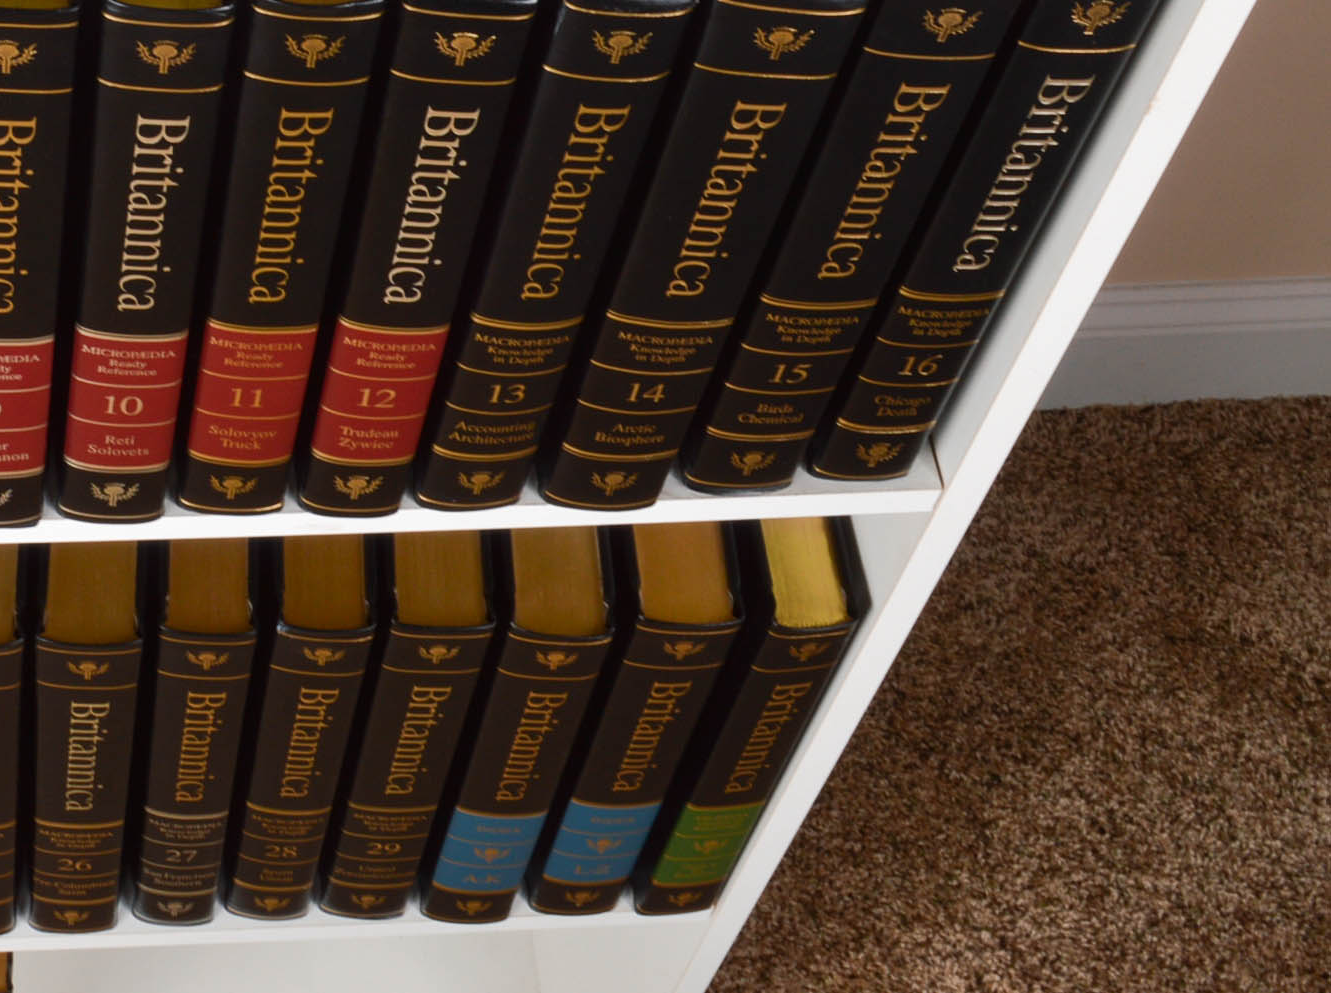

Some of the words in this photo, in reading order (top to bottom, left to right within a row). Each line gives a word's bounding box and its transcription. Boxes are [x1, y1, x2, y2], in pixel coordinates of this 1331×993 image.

[817, 81, 952, 280] Britannica
[952, 73, 1096, 273] Britannica
[248, 107, 334, 305] Britannica
[383, 105, 481, 305] Britannica
[520, 103, 631, 301] Britannica
[665, 100, 787, 298] Britannica
[117, 113, 191, 312] Britannica
[109, 359, 147, 369] Ready
[224, 358, 284, 369] Reference
[236, 351, 275, 361] Ready
[356, 358, 416, 369] Reference
[369, 351, 405, 361] Ready
[897, 354, 943, 376] 16
[97, 366, 158, 376] Reference
[768, 364, 812, 384] 15
[230, 388, 263, 408] 11
[357, 388, 397, 408] 12
[488, 384, 526, 404] 13
[626, 383, 666, 403] 14
[104, 396, 144, 416] 10
[105, 435, 135, 445] Reti
[339, 426, 399, 439] Trudeau
[594, 432, 666, 447] Biosphere
[220, 437, 262, 450] Truck
[280, 687, 340, 799] Britannica
[385, 685, 452, 795] Britannica
[495, 691, 569, 801] Britannica
[613, 681, 693, 792] Britannica
[725, 682, 813, 794] Britannica
[65, 701, 110, 811] Britannica
[175, 691, 227, 803] Britannica
[166, 850, 197, 863] 27
[265, 846, 298, 858] 28
[366, 842, 402, 855] 29
[57, 859, 92, 872] 26
